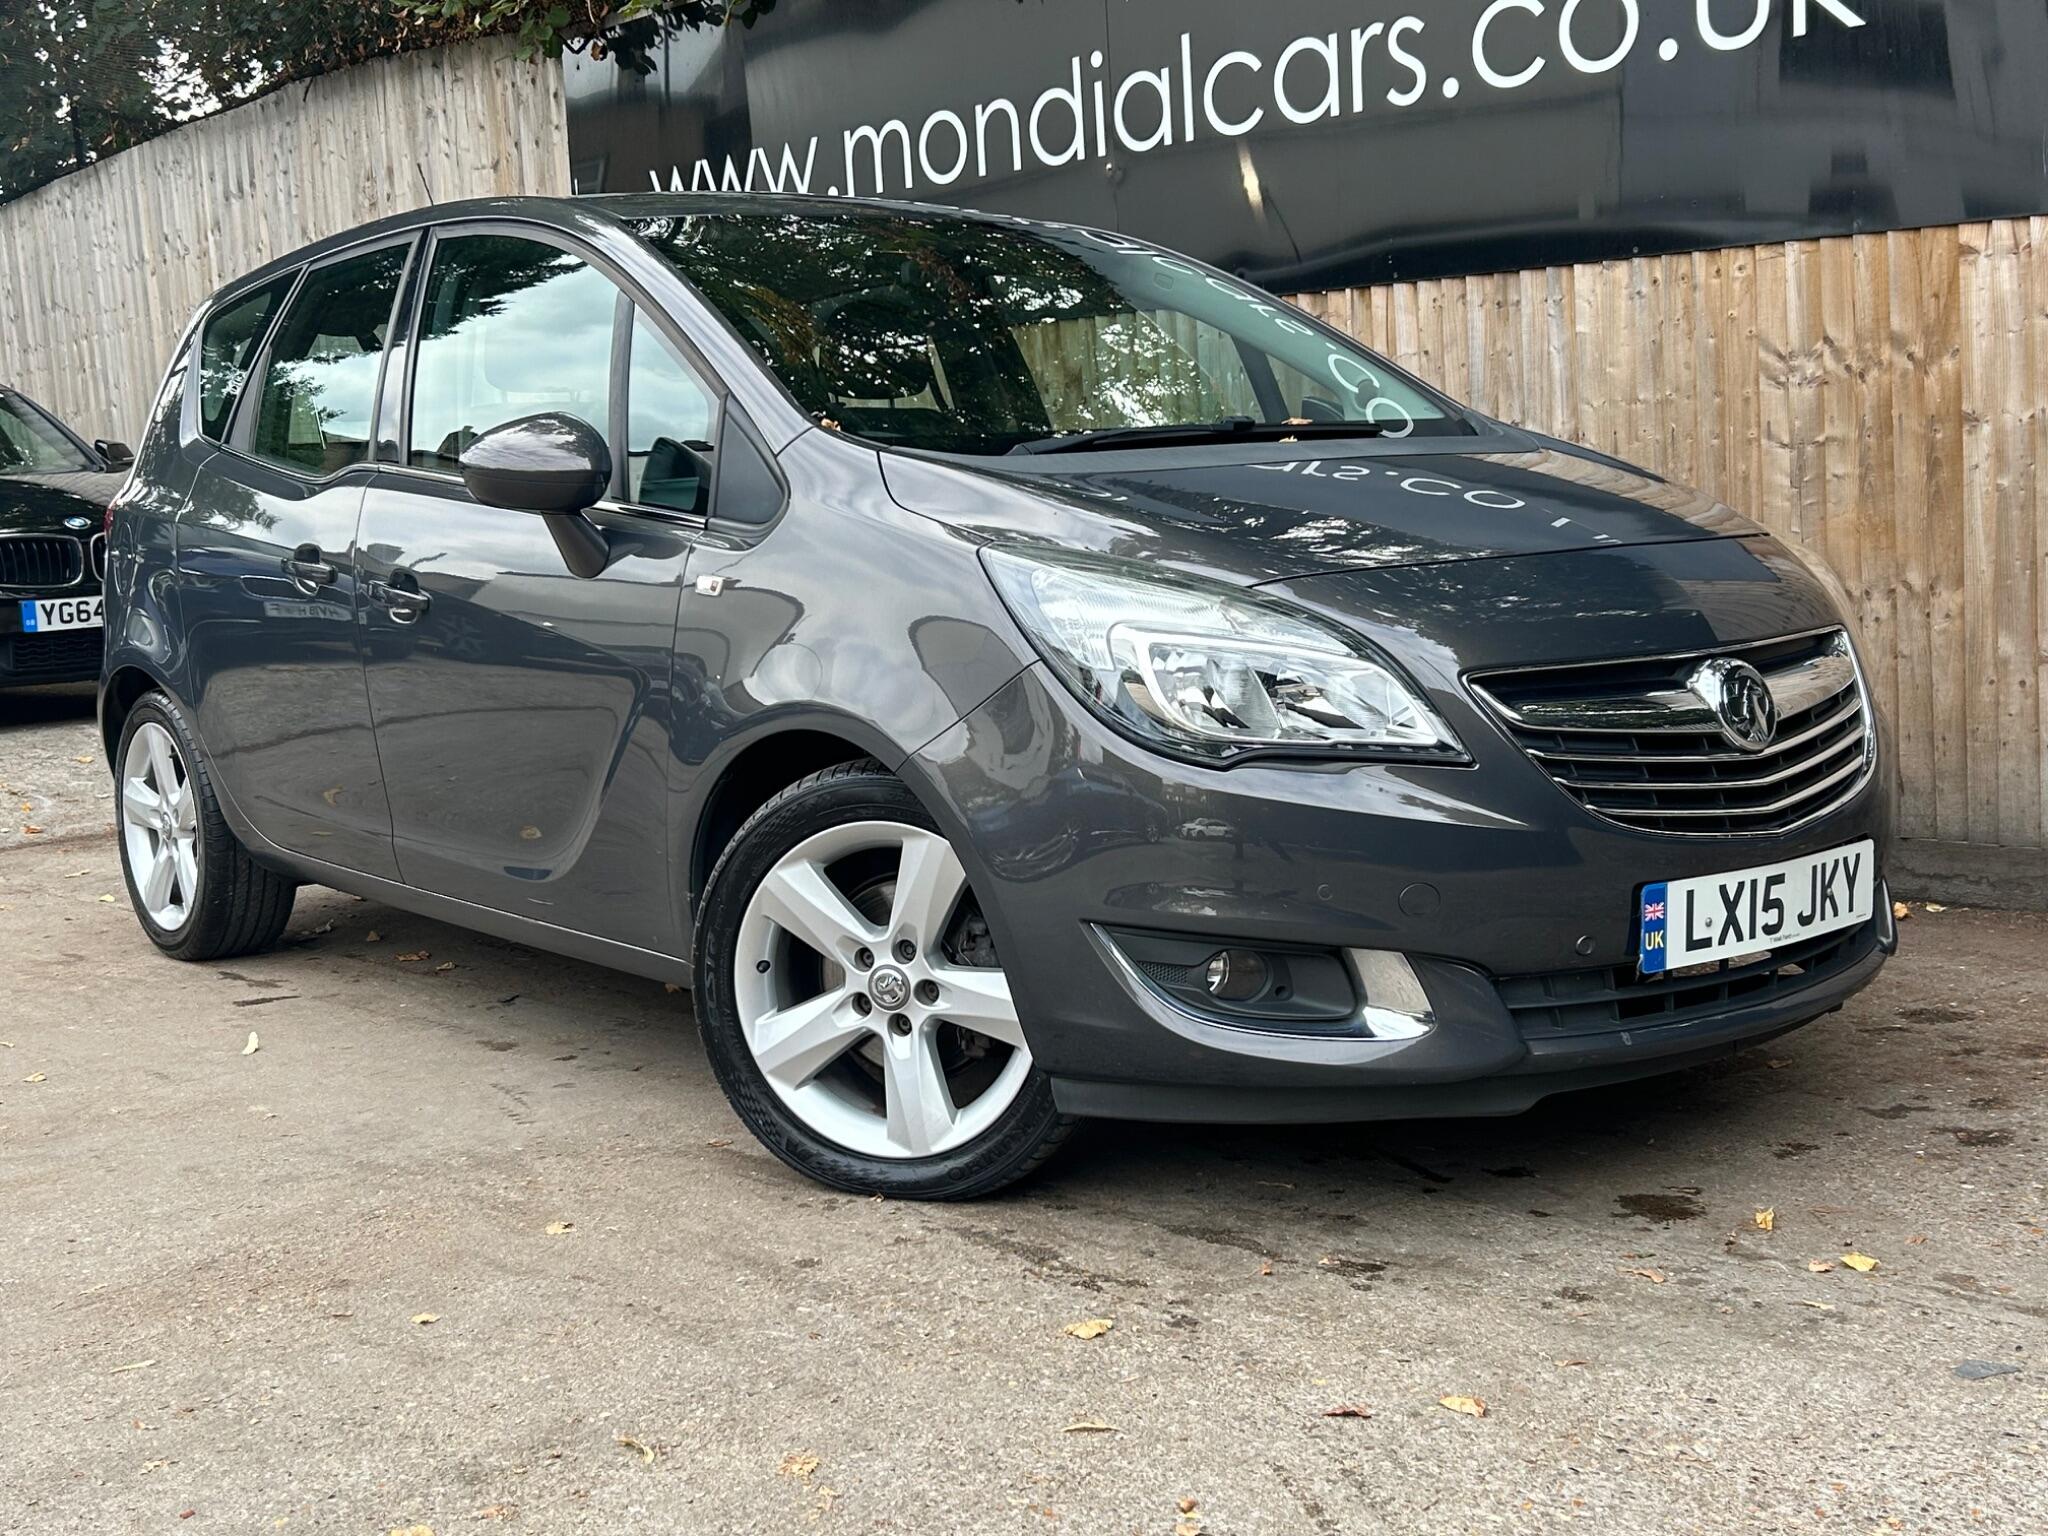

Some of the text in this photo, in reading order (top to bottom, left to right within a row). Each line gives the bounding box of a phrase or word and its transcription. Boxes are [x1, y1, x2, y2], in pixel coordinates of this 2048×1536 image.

[40, 599, 103, 625] YG64
[1685, 852, 1861, 952] LX15 JKY
[1644, 931, 1664, 951] UK
